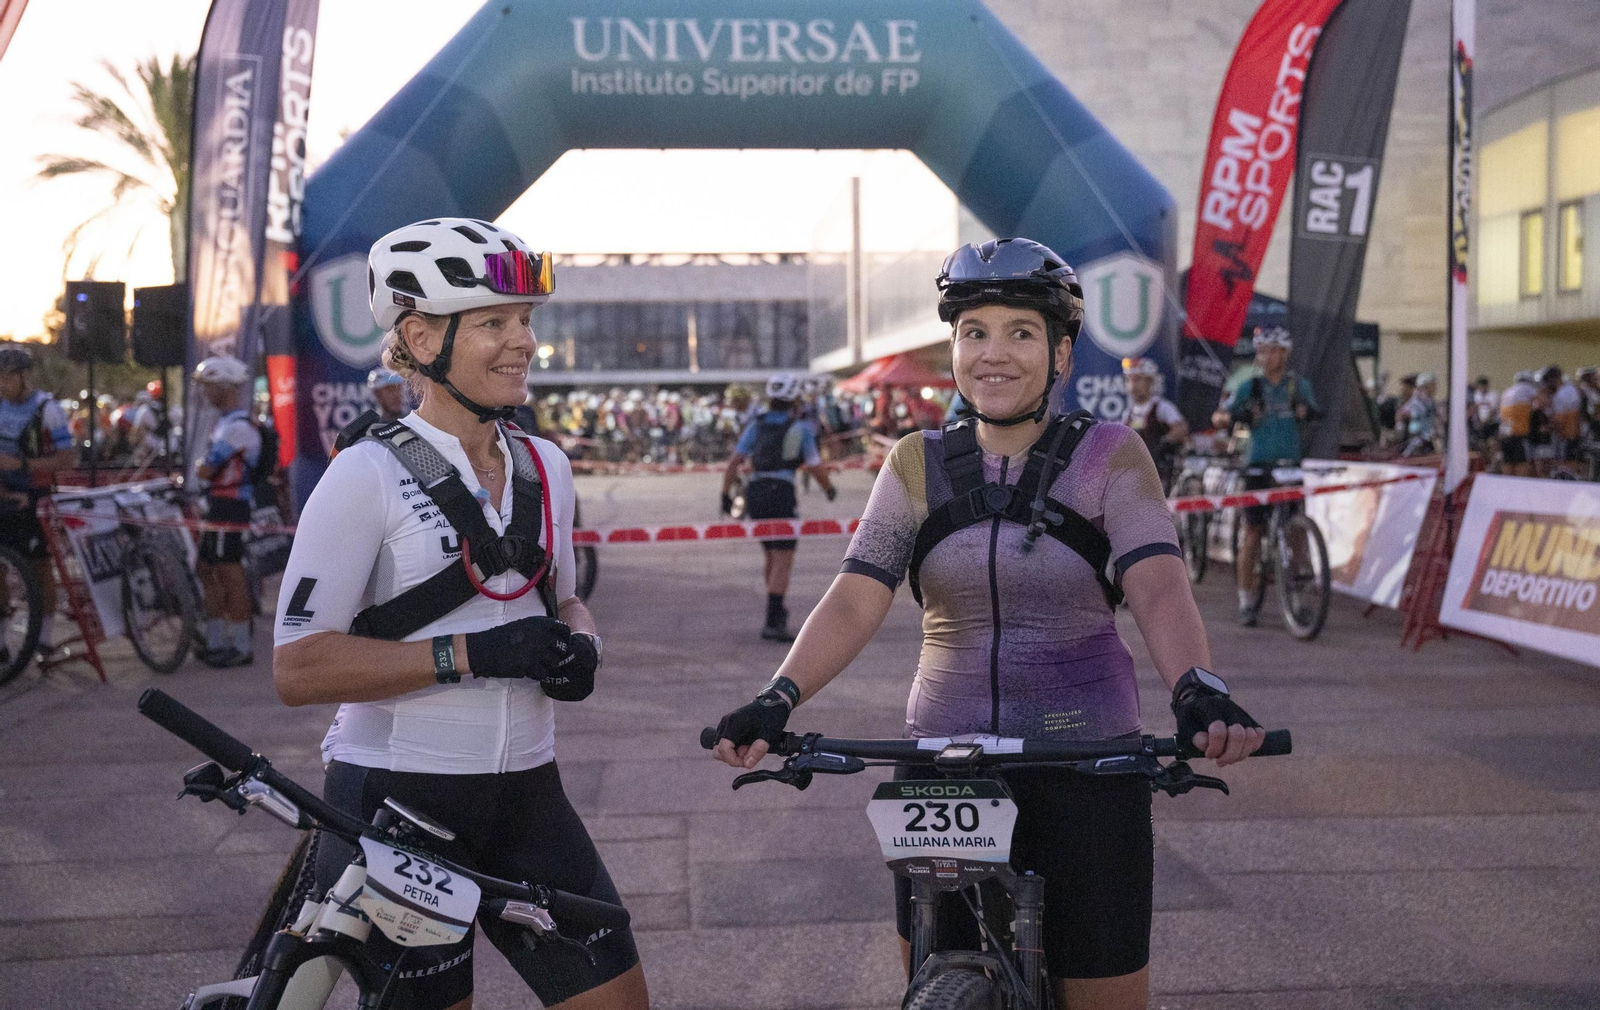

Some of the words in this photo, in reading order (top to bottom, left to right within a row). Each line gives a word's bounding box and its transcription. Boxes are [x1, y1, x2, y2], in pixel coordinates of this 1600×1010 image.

[570, 17, 921, 63] UNIVERSAE
[571, 68, 694, 95] Instituto
[703, 68, 829, 100] Superior
[834, 68, 873, 95] de
[881, 69, 920, 96] FP
[1238, 22, 1322, 231] SPORTS
[1202, 108, 1262, 230] RPM
[1306, 161, 1343, 233] RAC
[1345, 166, 1372, 236] 1
[1096, 271, 1152, 340] U
[1076, 375, 1126, 395] CHA
[412, 500, 435, 511] SHI
[1480, 568, 1597, 611] DEPORTIVO
[439, 650, 448, 668] 232
[541, 676, 570, 686] STRA
[1044, 710, 1081, 718] SPECIALIZED
[1045, 721, 1086, 730] COMPONENTS
[903, 802, 980, 832] 230
[893, 837, 951, 847] LILLIANA
[953, 837, 997, 847] MARIA
[393, 850, 453, 896] 232
[403, 884, 439, 907] PETRA
